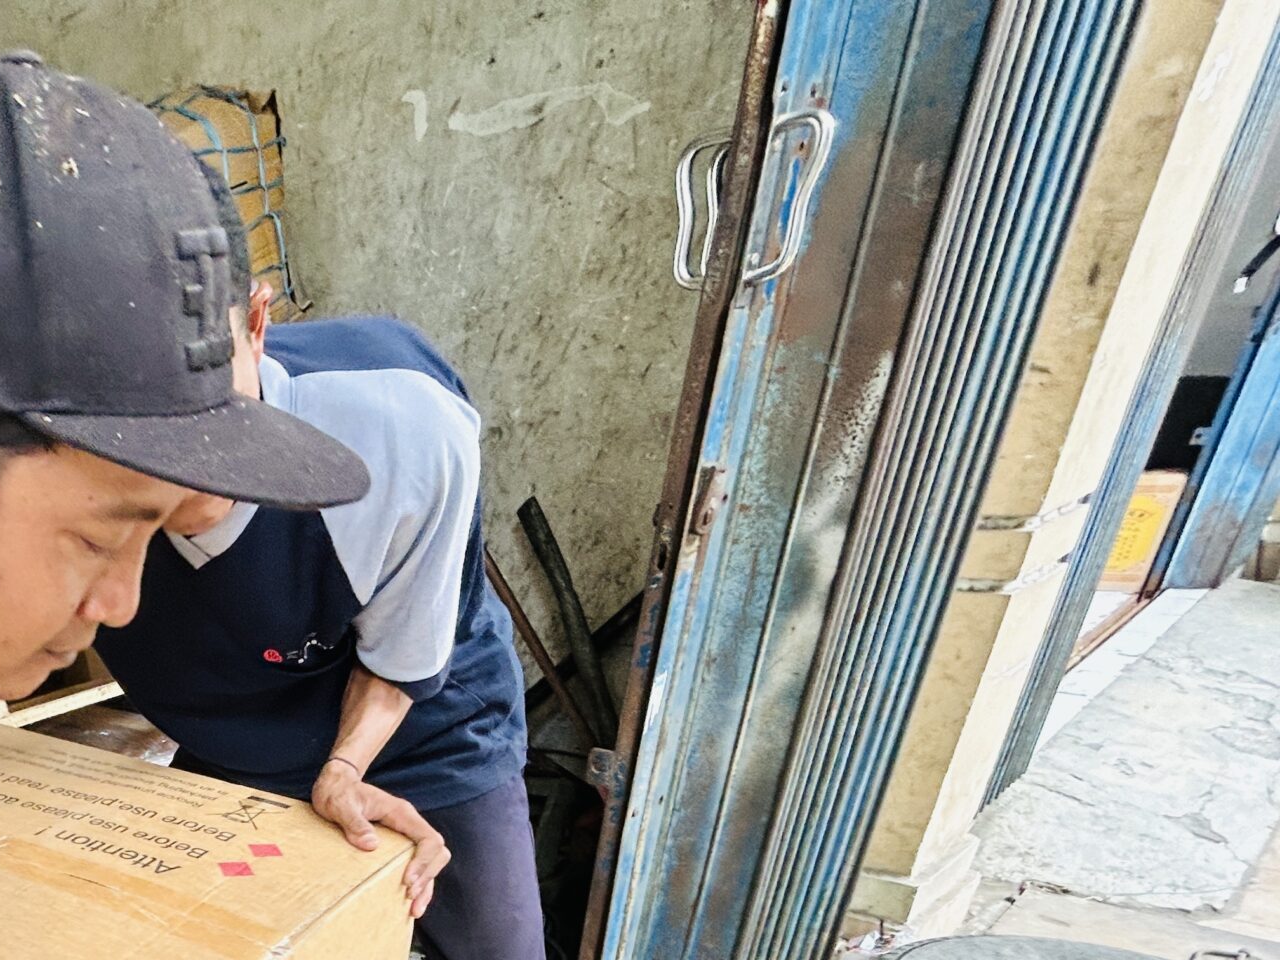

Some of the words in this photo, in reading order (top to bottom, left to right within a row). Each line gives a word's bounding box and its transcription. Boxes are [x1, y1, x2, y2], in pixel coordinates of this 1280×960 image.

[2, 775, 49, 791] read
[20, 799, 130, 835] use,please
[50, 785, 158, 819] use,please
[161, 813, 237, 843] Before
[54, 828, 184, 876] Attention
[132, 829, 209, 860] Before
